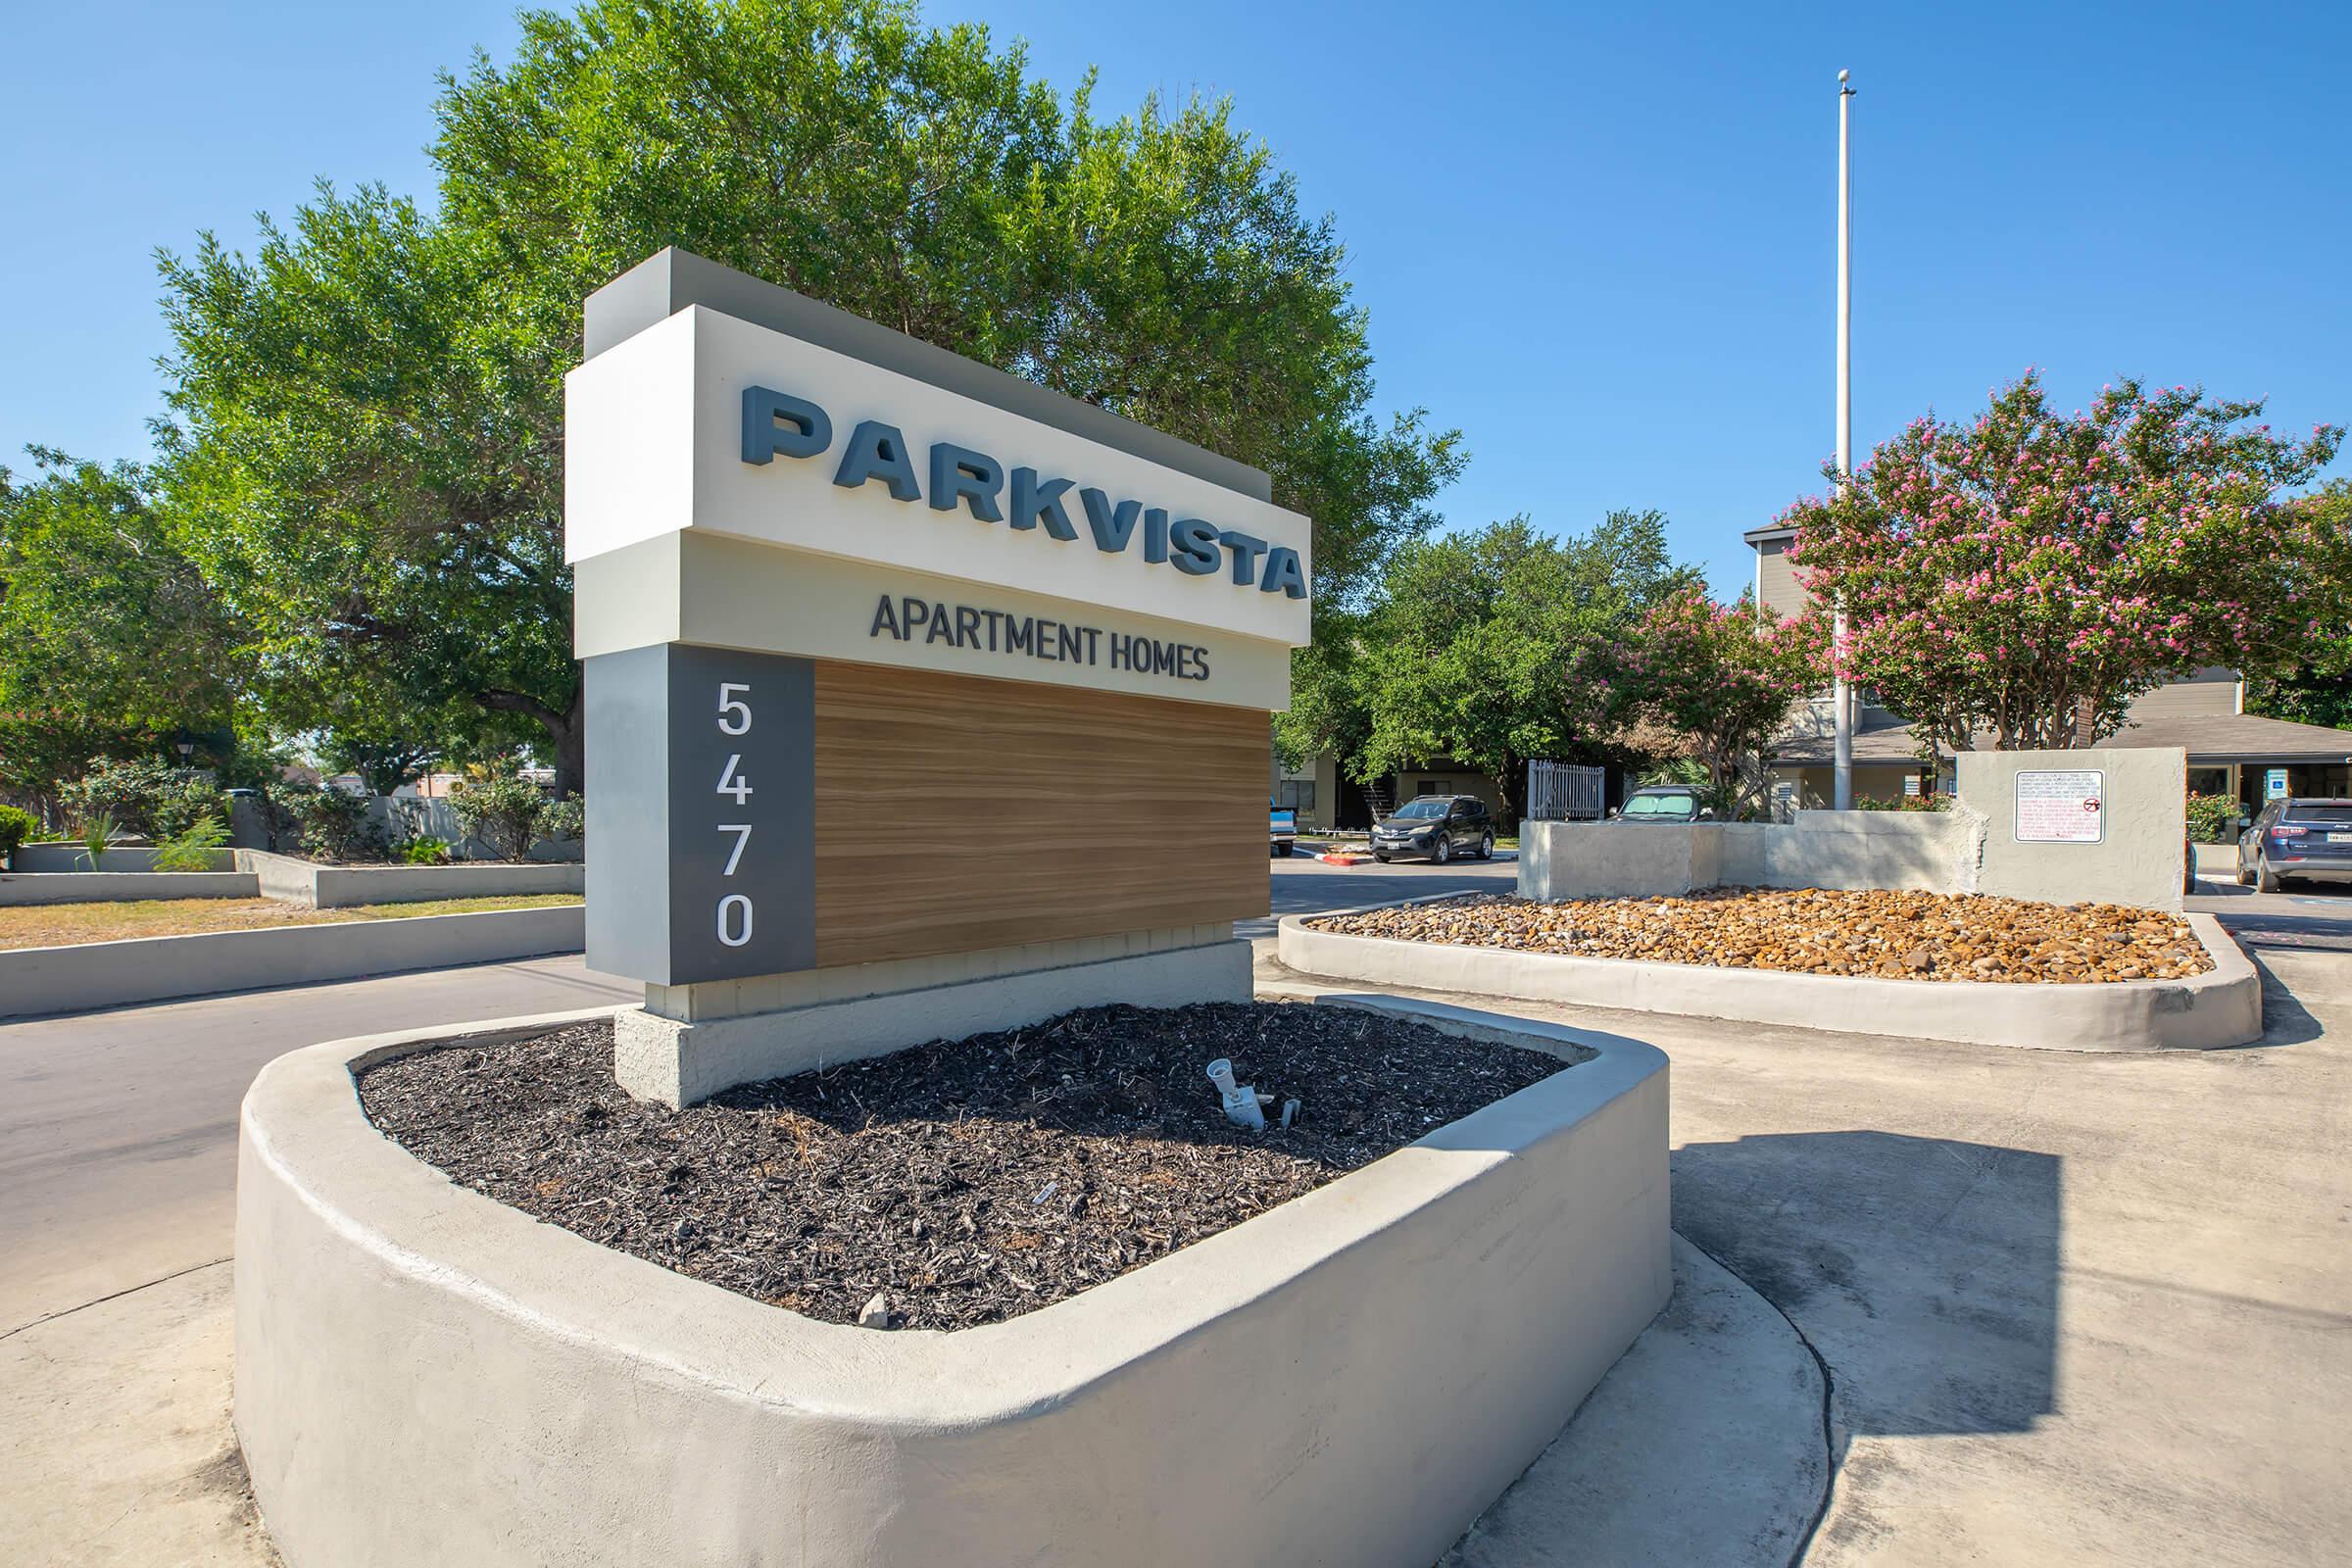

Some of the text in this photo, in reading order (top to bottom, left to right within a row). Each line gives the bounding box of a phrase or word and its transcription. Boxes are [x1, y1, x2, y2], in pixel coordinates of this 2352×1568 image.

[741, 384, 1307, 600] PARKVISTA
[870, 595, 1210, 681] APARTMENT HOMES
[716, 683, 754, 946] 5470
